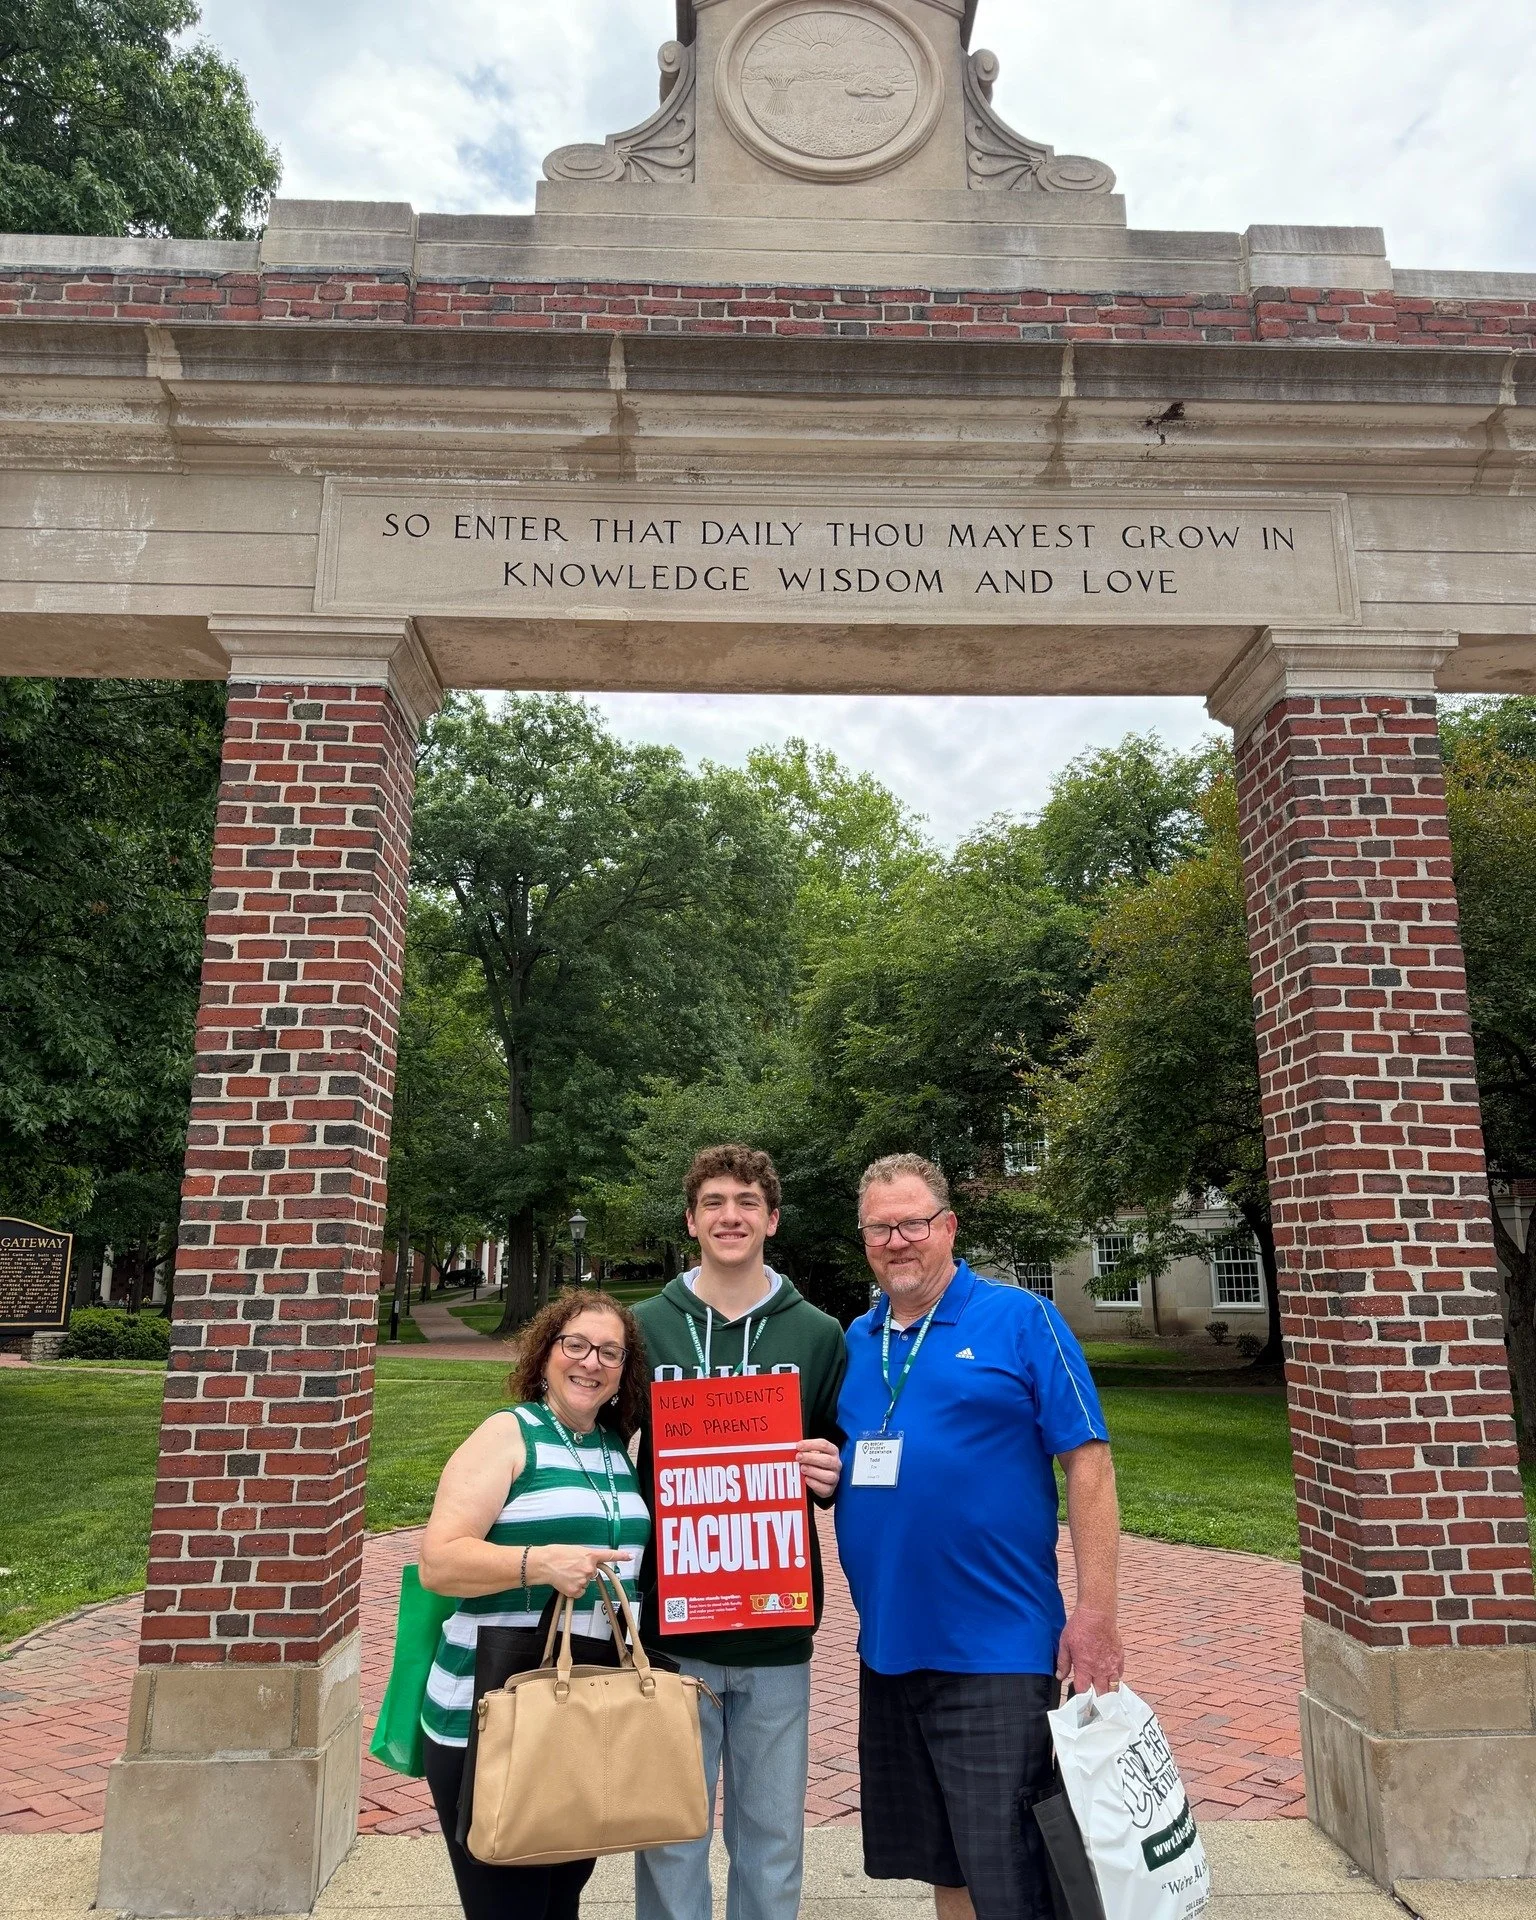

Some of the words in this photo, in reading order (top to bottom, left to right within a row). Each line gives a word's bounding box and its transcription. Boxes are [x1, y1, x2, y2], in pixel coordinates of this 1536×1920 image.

[382, 513, 430, 538] SO
[454, 515, 569, 542] ENTER
[590, 518, 682, 544] THAT
[701, 521, 803, 546] DAILY
[826, 522, 924, 548] THOU
[948, 523, 1095, 548] MAYEST
[1121, 525, 1240, 549] GROW
[1262, 527, 1295, 551] IN
[503, 561, 750, 591] KNOWLEDGE
[778, 567, 944, 594] WISDOM
[974, 569, 1054, 594] AND
[1083, 570, 1178, 594] LOVE
[1, 1237, 66, 1249] GATEWAY
[689, 1326, 706, 1363] ORIENTATION
[659, 1394, 695, 1410] NEW
[705, 1386, 785, 1408] STUDENTS
[553, 1420, 569, 1441] BOBCAT
[665, 1422, 693, 1438] AND
[703, 1415, 769, 1435] PARENTS
[659, 1464, 742, 1507] STANDS
[743, 1461, 802, 1501] WITH
[662, 1510, 806, 1575] FACULTY!
[1185, 1896, 1205, 1912] COLLEGE
